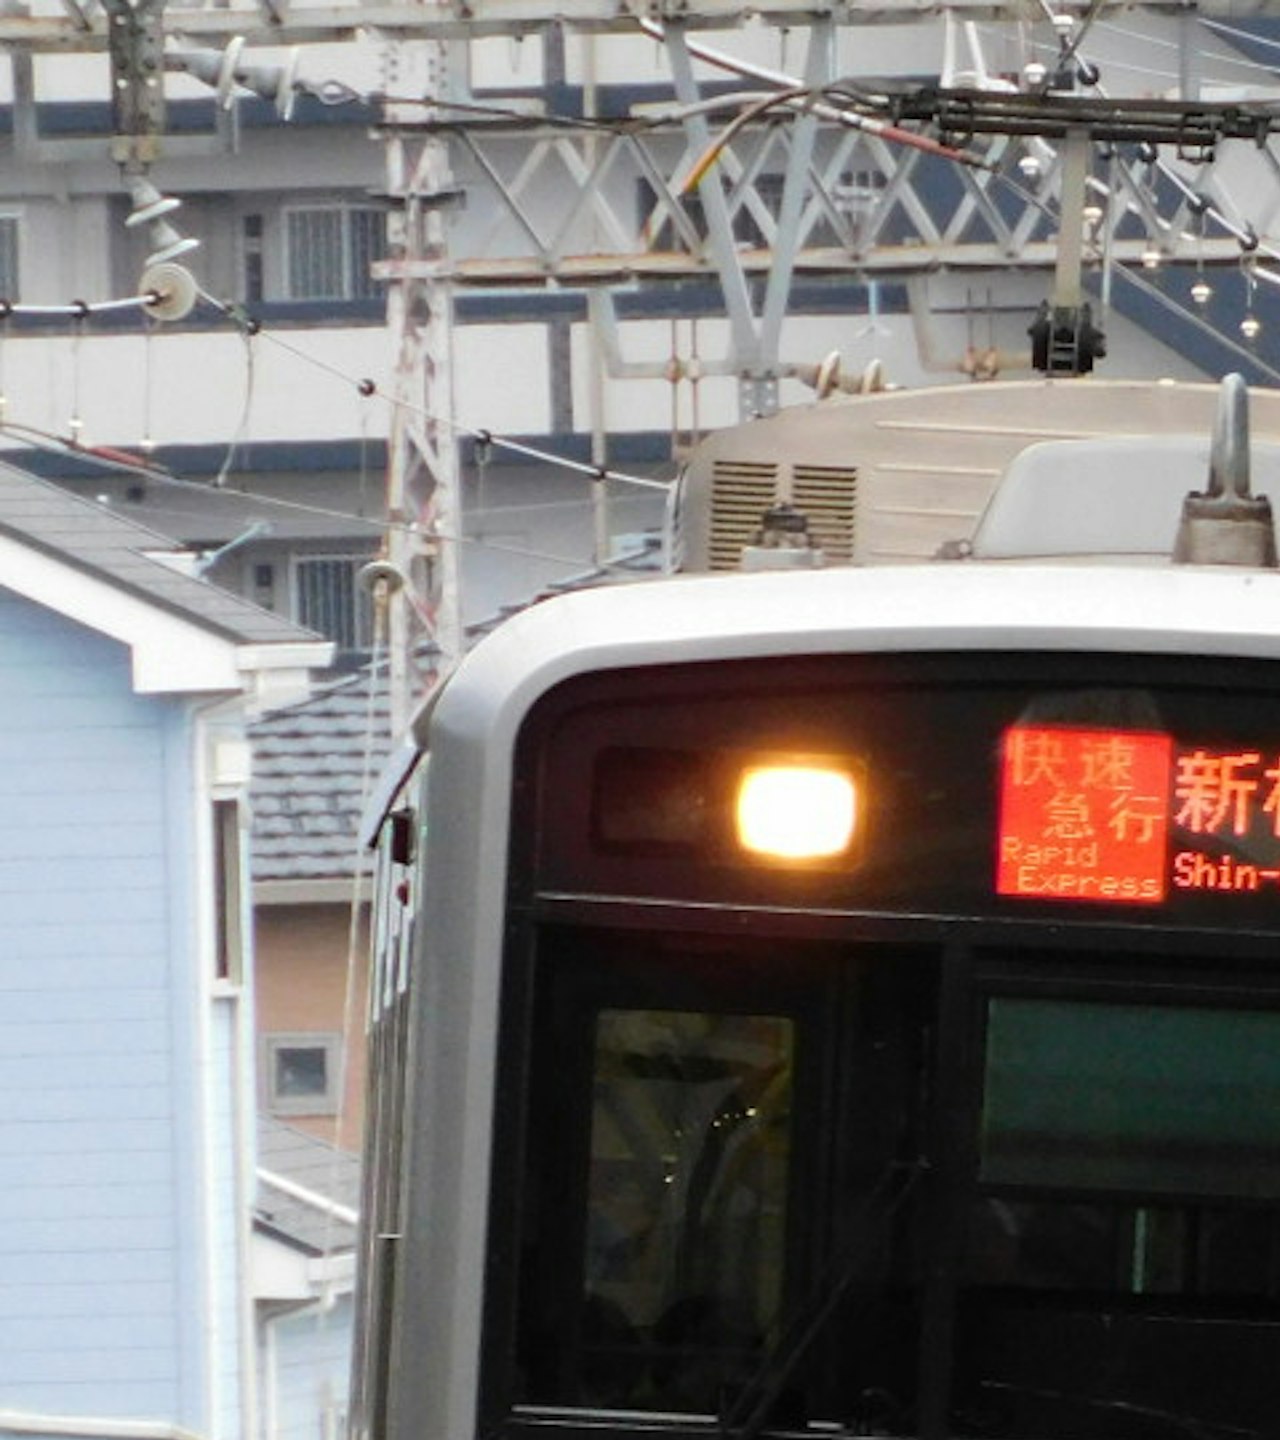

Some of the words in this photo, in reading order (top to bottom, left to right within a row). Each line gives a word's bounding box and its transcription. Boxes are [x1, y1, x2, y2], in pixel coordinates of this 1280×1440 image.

[1003, 732, 1137, 790] 快速
[1042, 788, 1163, 843] 急行
[1001, 836, 1098, 868] Rapid
[1017, 865, 1158, 897] Express
